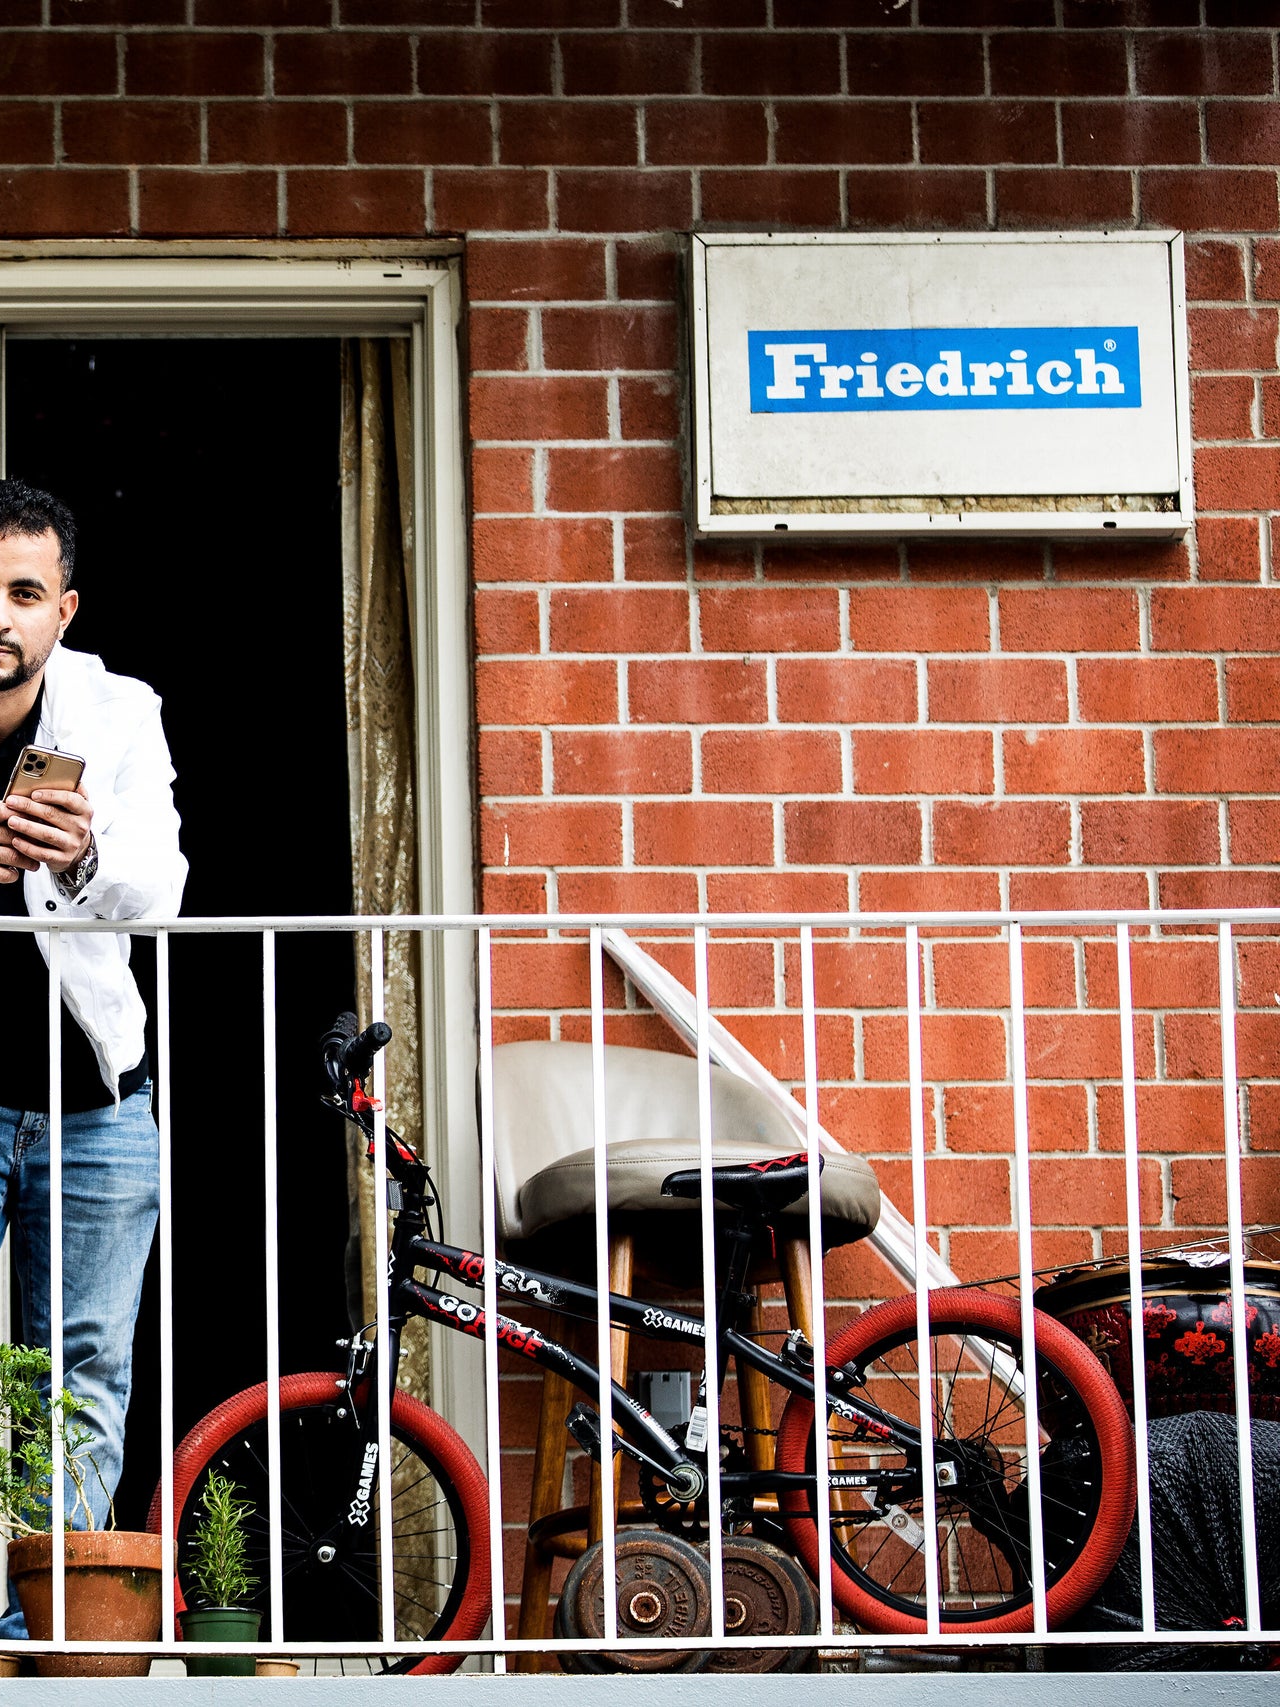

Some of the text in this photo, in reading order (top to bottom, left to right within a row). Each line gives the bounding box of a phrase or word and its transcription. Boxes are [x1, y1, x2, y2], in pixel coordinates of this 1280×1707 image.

[765, 343, 1125, 400] Friedrich
[663, 1316, 707, 1338] GAMES
[356, 1442, 379, 1500] GAMES
[831, 1476, 868, 1486] GAMES
